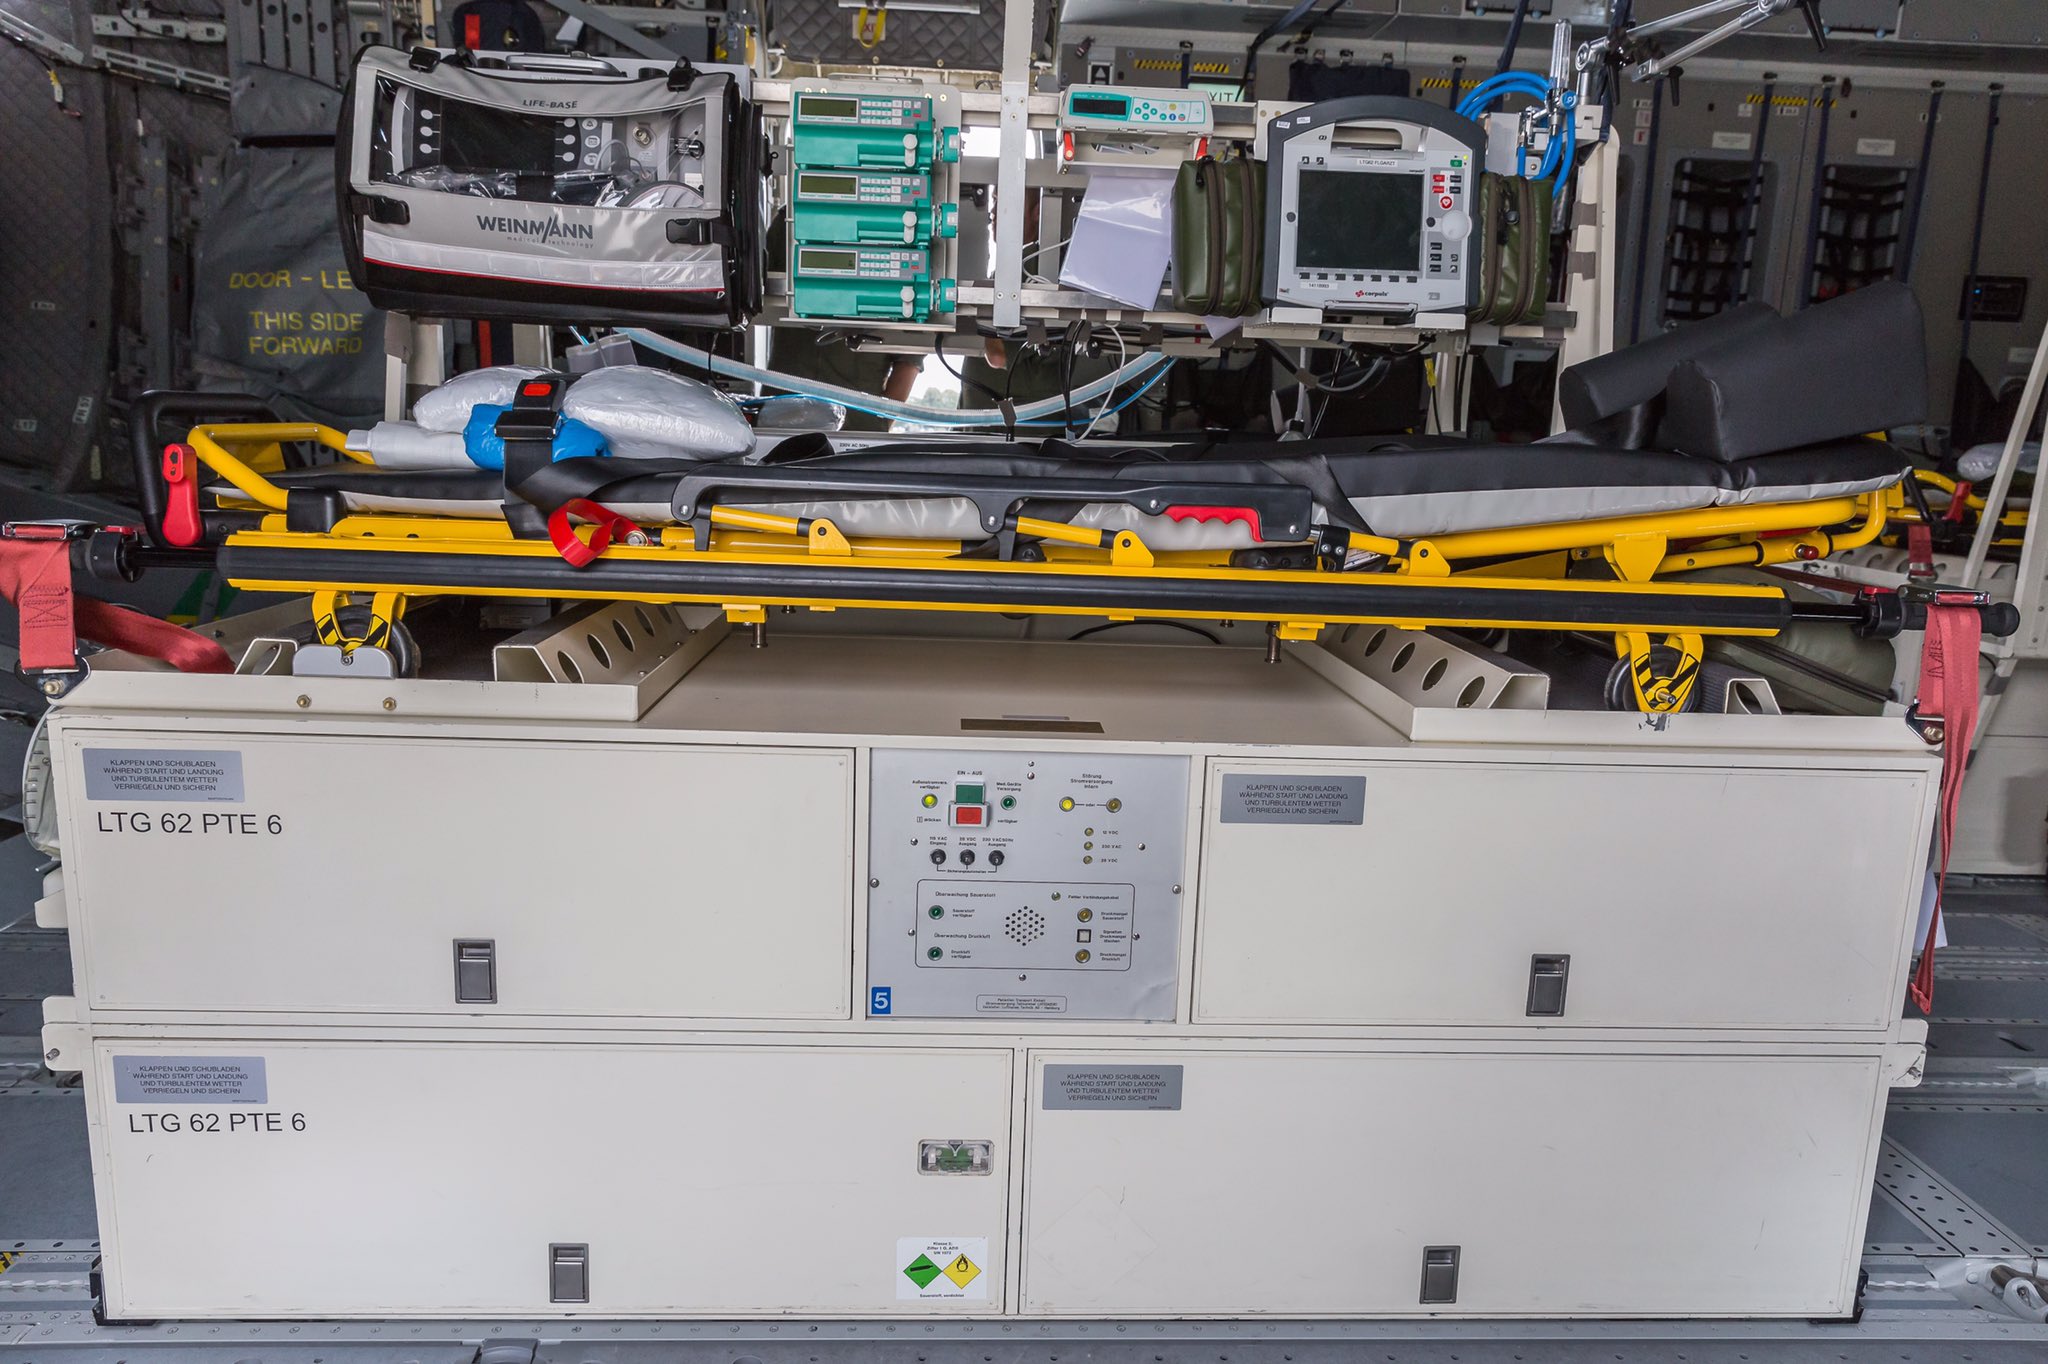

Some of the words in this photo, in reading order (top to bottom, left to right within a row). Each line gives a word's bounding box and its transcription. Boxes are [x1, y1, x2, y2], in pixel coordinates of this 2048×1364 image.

[522, 98, 578, 109] LIFE-BASE
[1209, 91, 1234, 102] XIT
[476, 214, 594, 244] WEINMANN
[548, 240, 594, 248] technology
[229, 270, 292, 288] DOOR
[320, 270, 353, 290] LE
[250, 311, 303, 330] THIS
[310, 312, 364, 332] SIDE
[250, 336, 362, 355] FORWARD
[103, 766, 143, 774] WÄHREND
[98, 812, 151, 832] LTG
[161, 812, 193, 834] 62
[202, 814, 258, 834] PTE
[267, 814, 283, 834] 6
[874, 992, 888, 1010] 5
[129, 1113, 181, 1132] LTG
[190, 1113, 220, 1132] 62
[230, 1112, 282, 1132] PTE
[292, 1112, 306, 1132] 6
